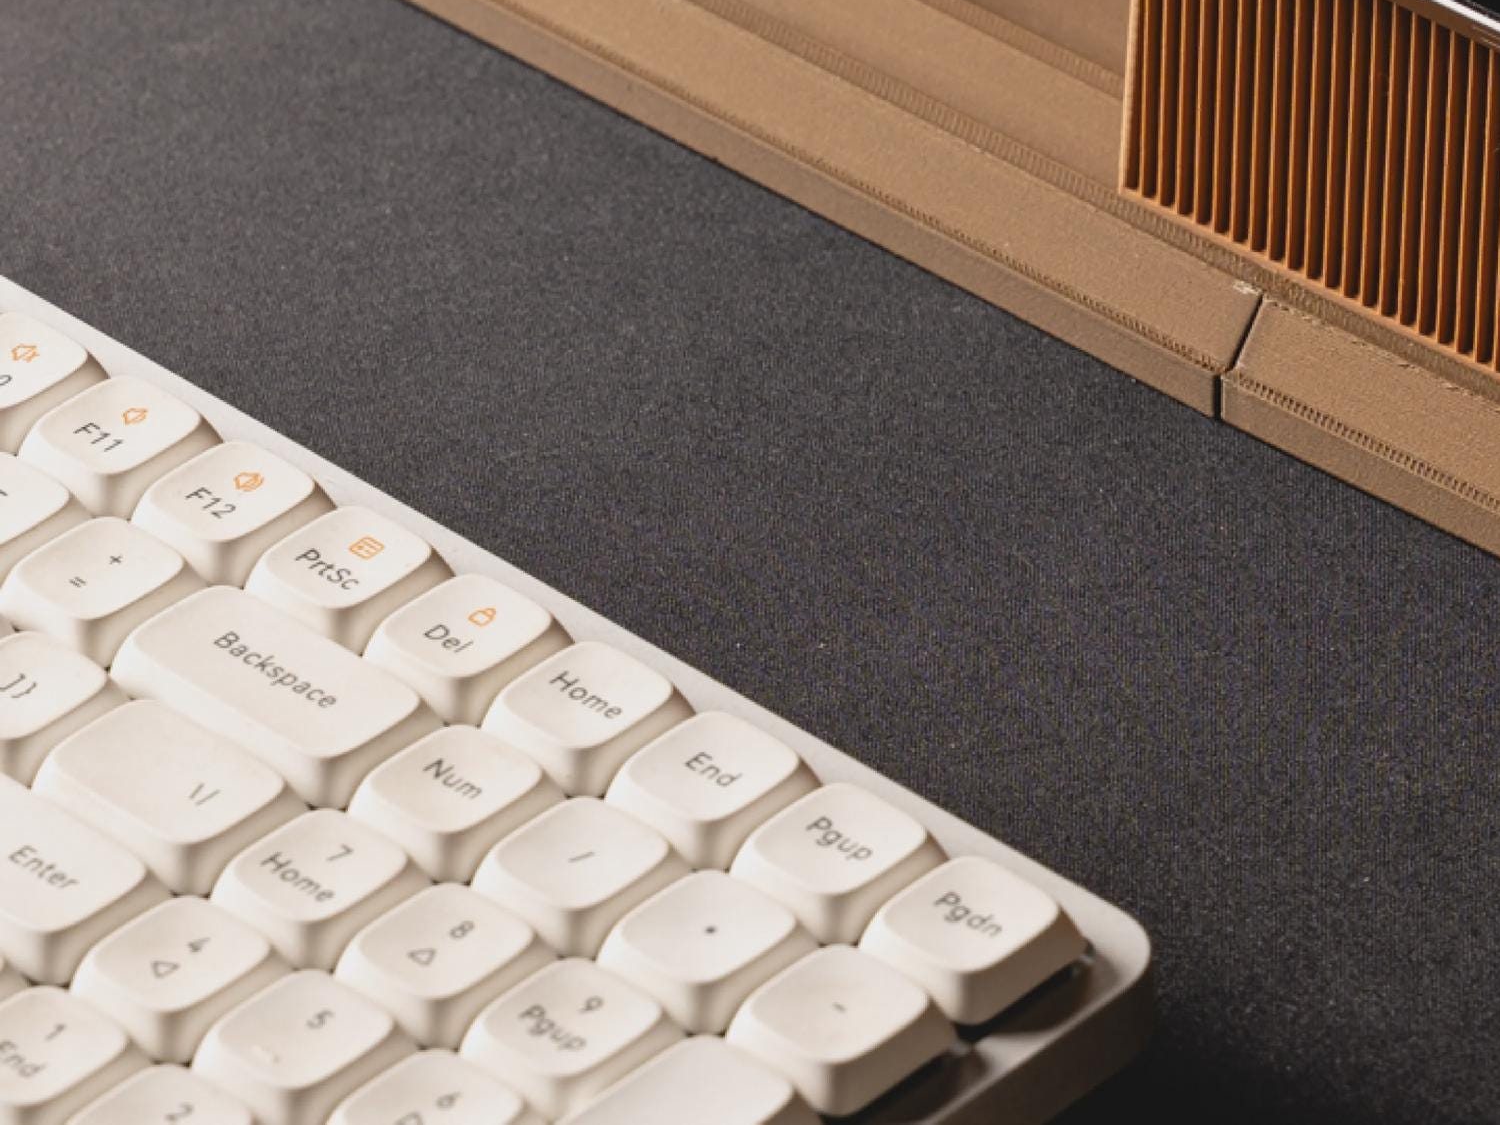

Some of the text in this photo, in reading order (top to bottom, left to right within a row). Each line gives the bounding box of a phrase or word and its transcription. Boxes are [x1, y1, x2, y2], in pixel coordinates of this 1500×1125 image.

[73, 422, 125, 453] F11
[185, 487, 237, 520] F12
[294, 548, 361, 591] PrtSc
[423, 624, 473, 654] Del
[213, 631, 338, 709] Backspace
[549, 671, 623, 720] Home
[423, 758, 483, 799] Num
[684, 752, 742, 787] End
[326, 844, 353, 863] 7
[806, 816, 873, 861] Pgup
[8, 845, 79, 890] Enter
[260, 851, 337, 903] Home
[449, 920, 476, 940] 8
[934, 891, 1003, 937] Pgdn
[187, 937, 210, 954] 4
[306, 1010, 334, 1029] 5
[580, 995, 604, 1014] 9
[45, 1023, 66, 1041] 1
[519, 1004, 589, 1052] Pgup
[165, 1103, 195, 1123] 2
[436, 1091, 461, 1110] 6
